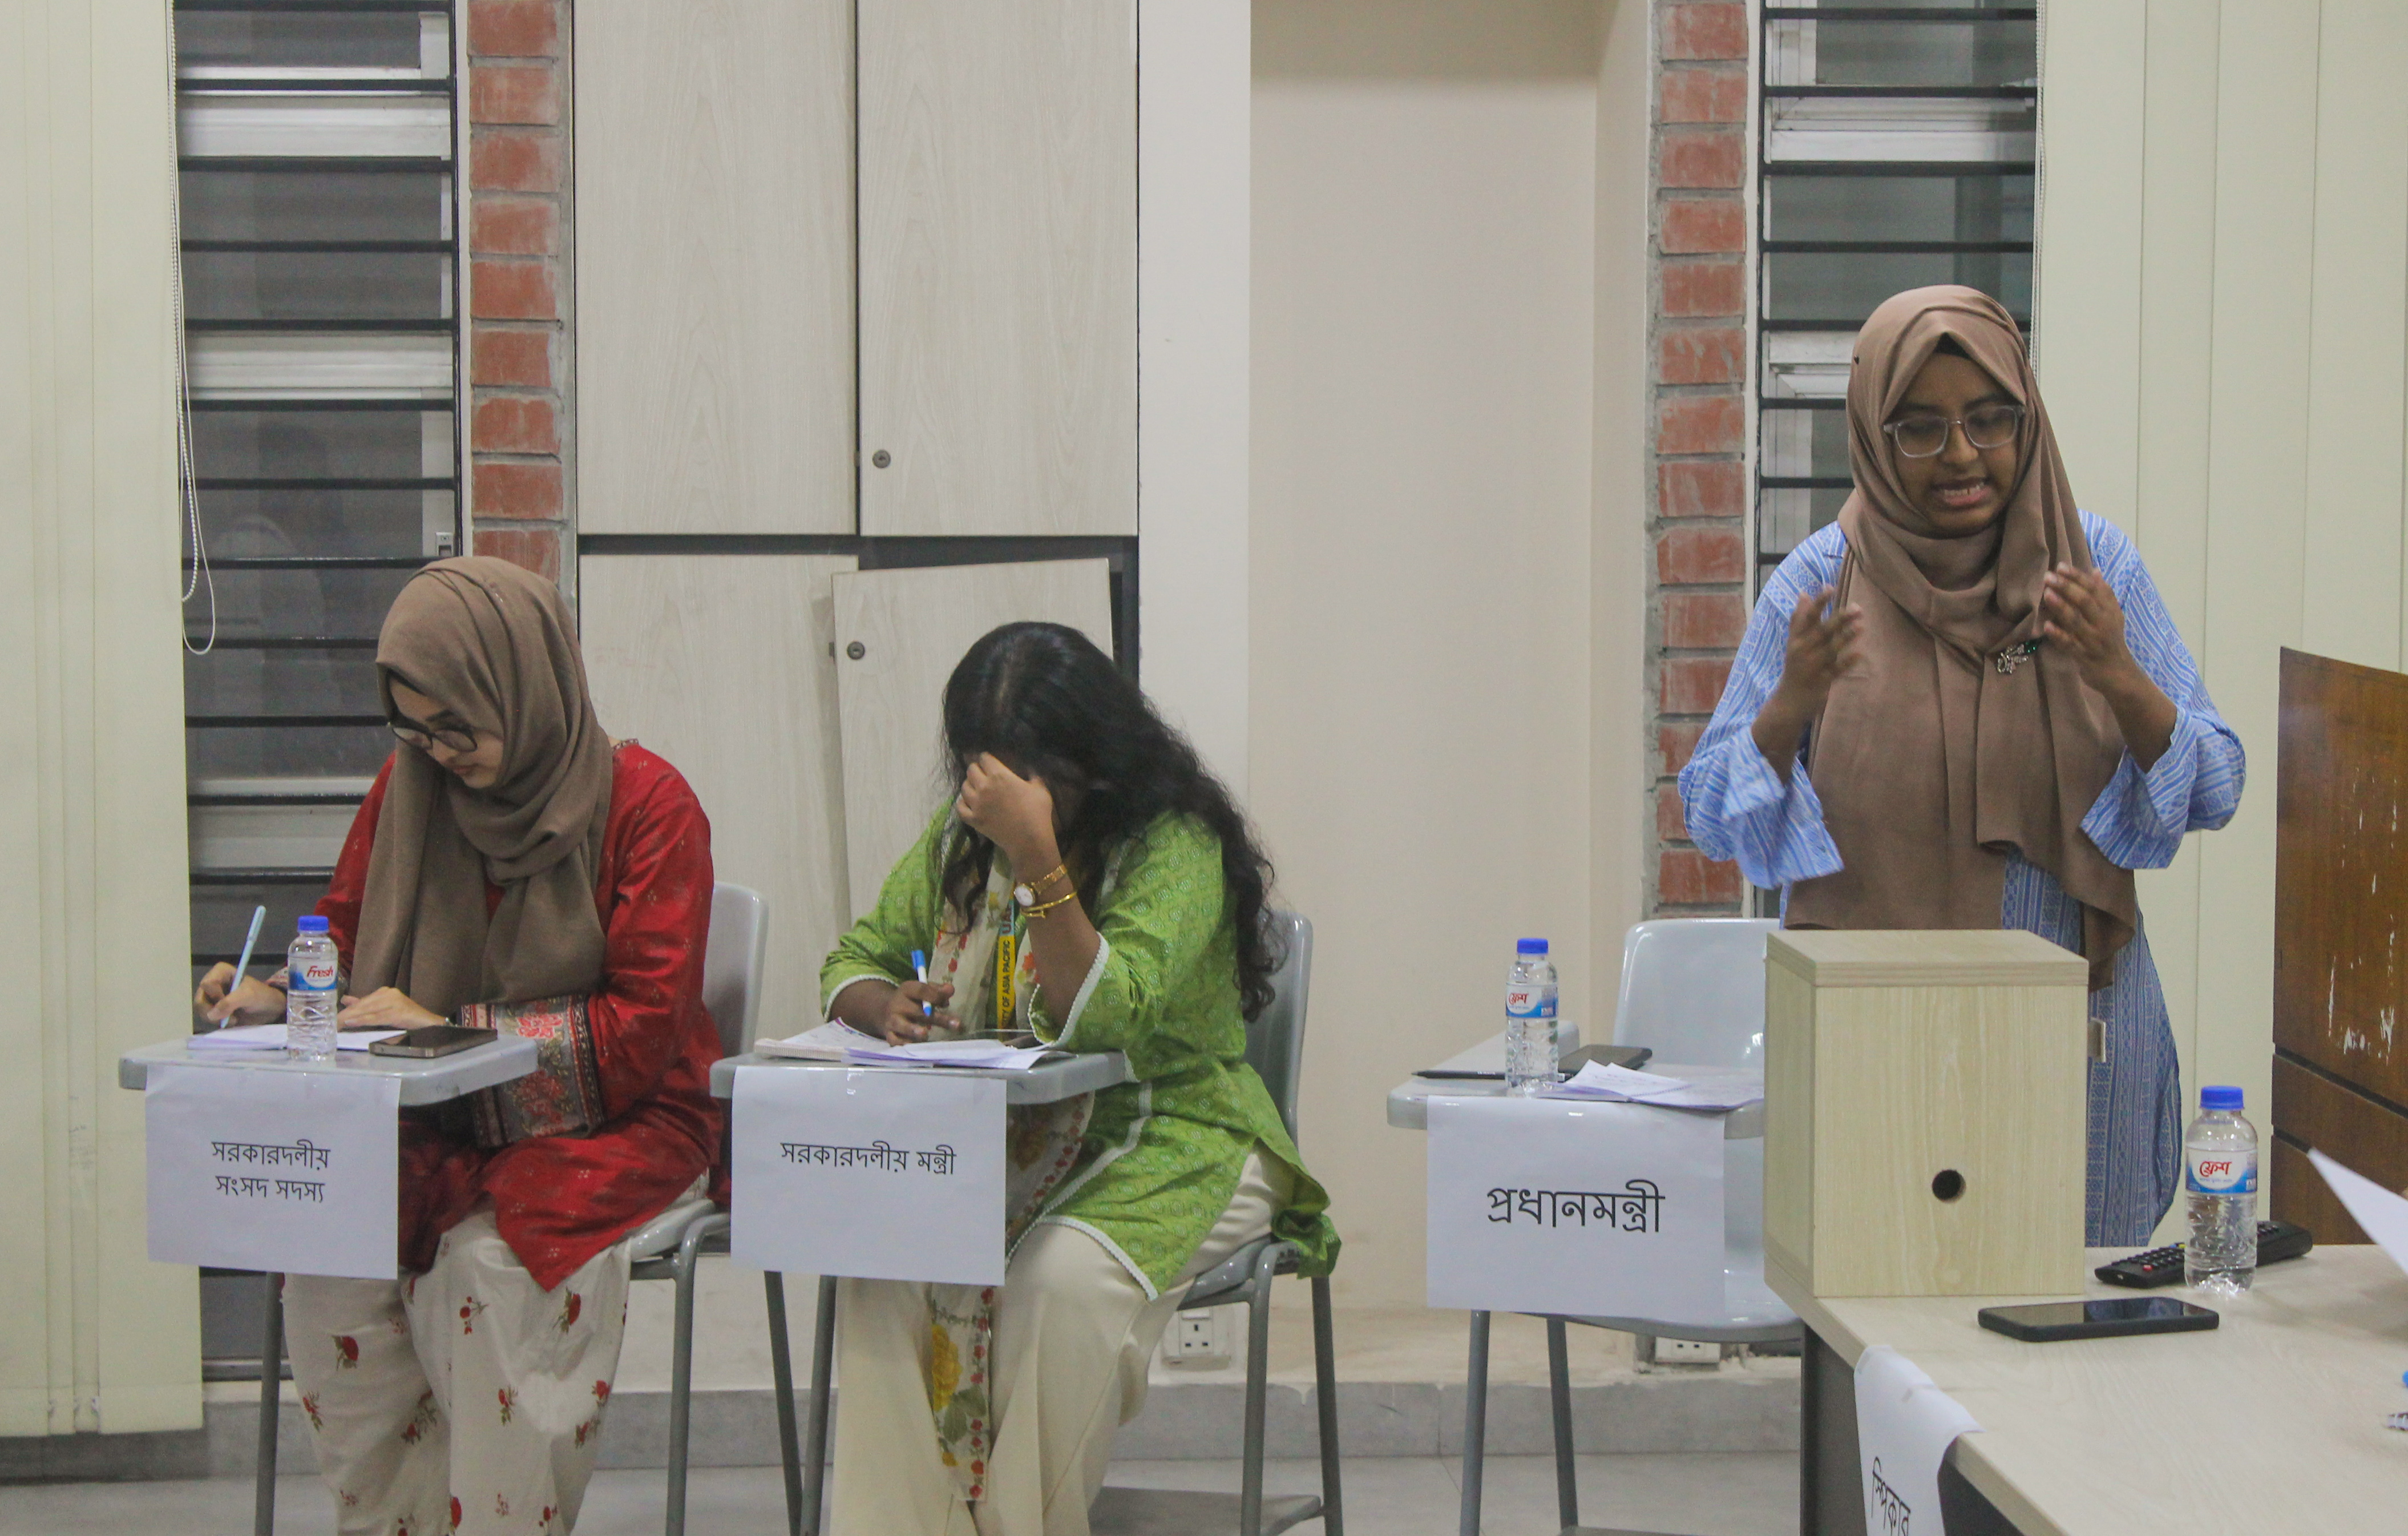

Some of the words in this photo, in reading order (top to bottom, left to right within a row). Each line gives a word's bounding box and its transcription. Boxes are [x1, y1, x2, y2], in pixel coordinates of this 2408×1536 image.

[307, 965, 334, 978] Fresh
[1002, 974, 1011, 994] ASIA
[1002, 995, 1010, 1007] OF
[211, 1139, 331, 1171] সরকারদলীয়
[780, 1140, 910, 1173] সরকারদলীয়
[916, 1144, 957, 1175] মন্ত্রী
[215, 1176, 269, 1198] সংসদ
[274, 1180, 326, 1203] সদস্য
[1486, 1179, 1666, 1233] প্রধানমন্ত্রী
